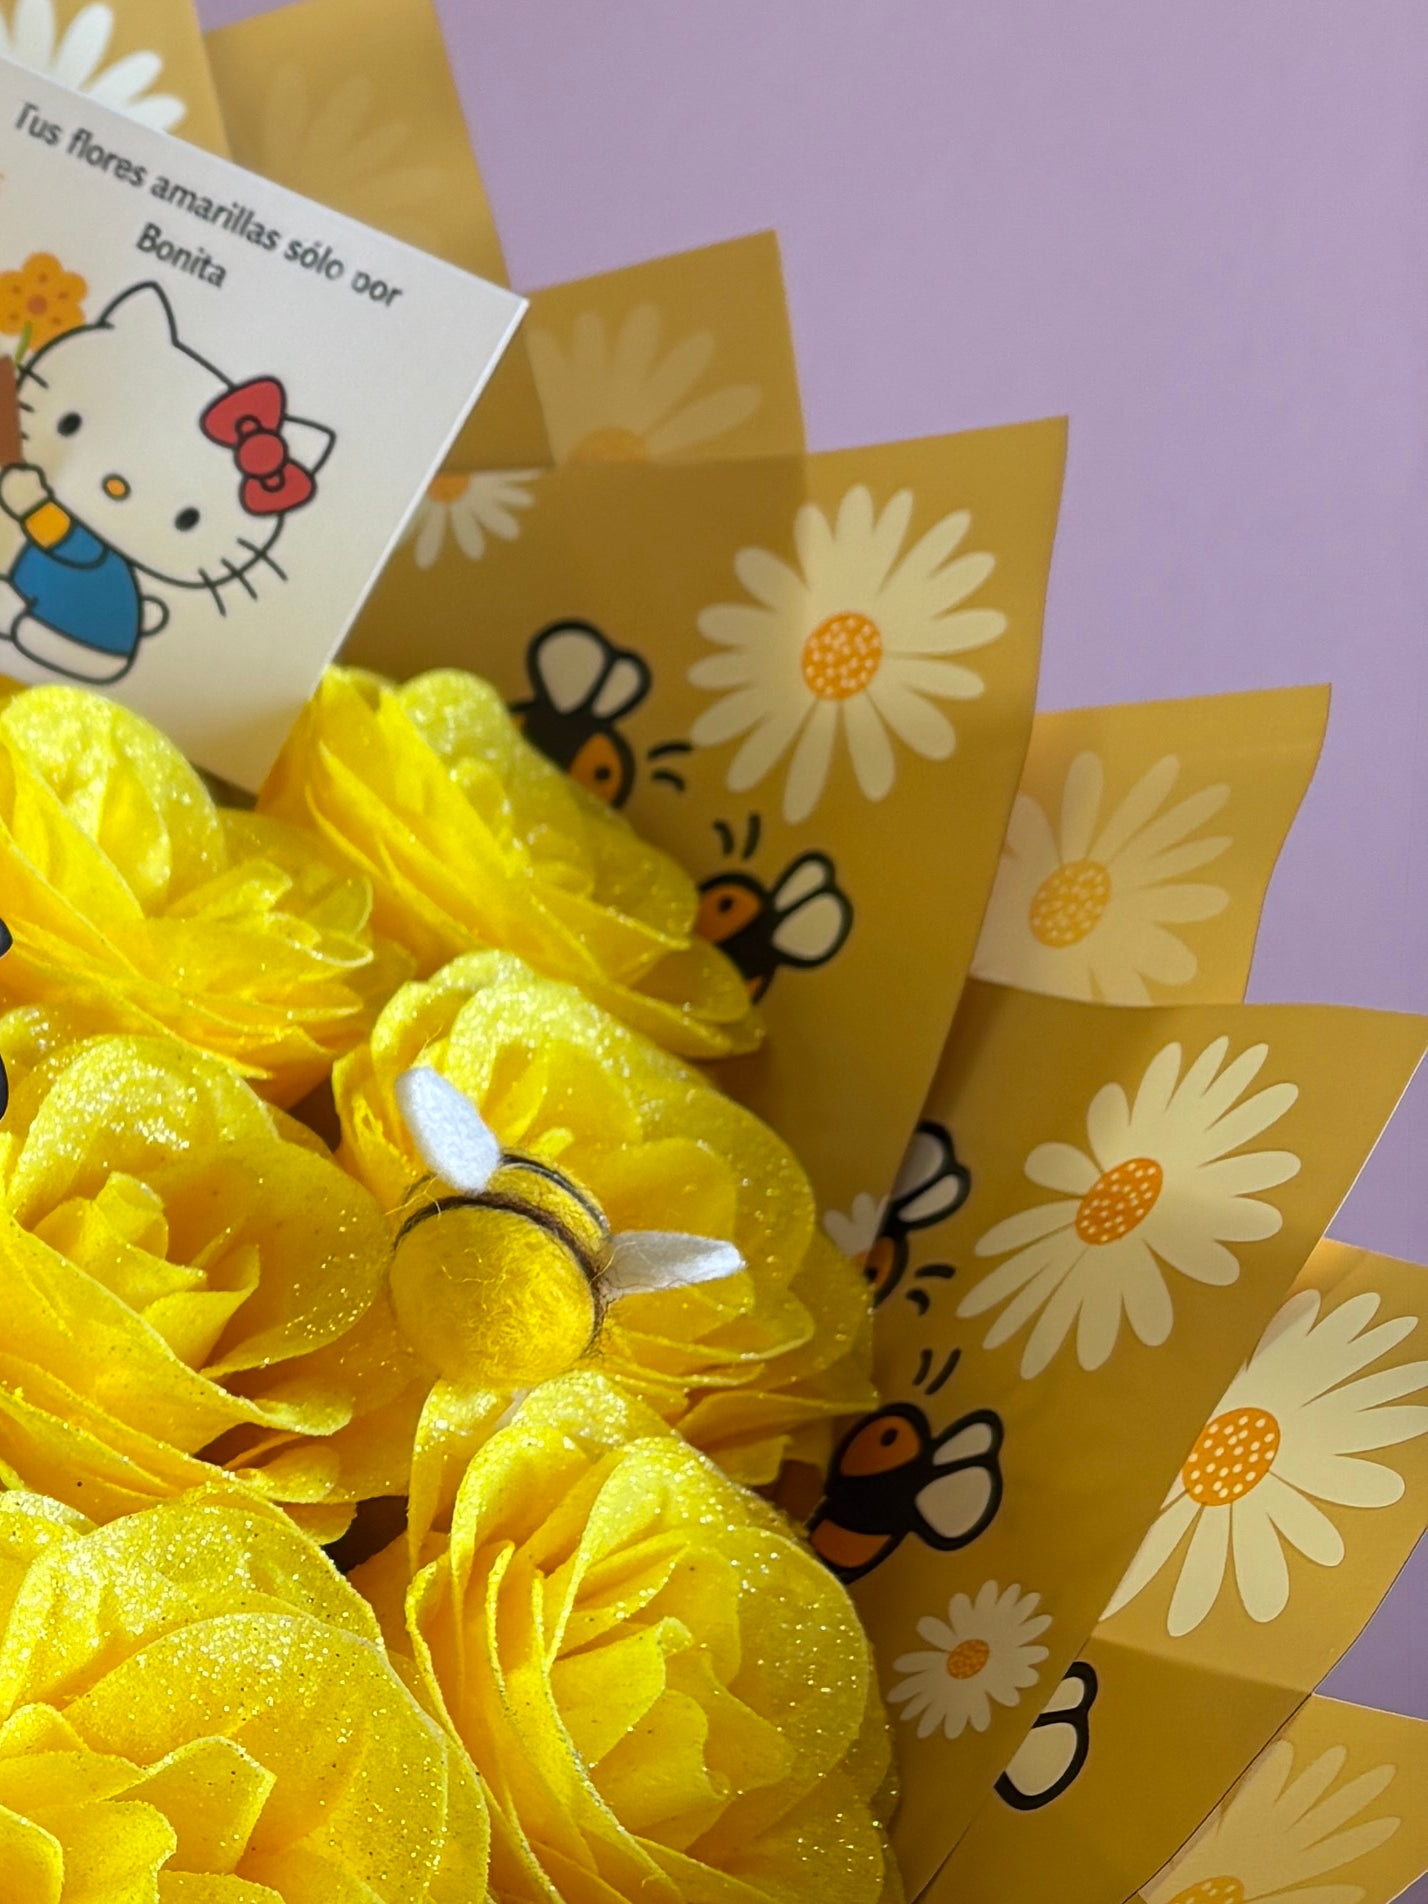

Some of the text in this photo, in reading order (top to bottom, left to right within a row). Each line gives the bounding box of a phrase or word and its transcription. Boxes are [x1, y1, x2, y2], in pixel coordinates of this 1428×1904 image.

[14, 102, 62, 147] Tus
[66, 127, 147, 187] flores
[150, 175, 281, 252] amarillas
[136, 222, 228, 289] Bonita
